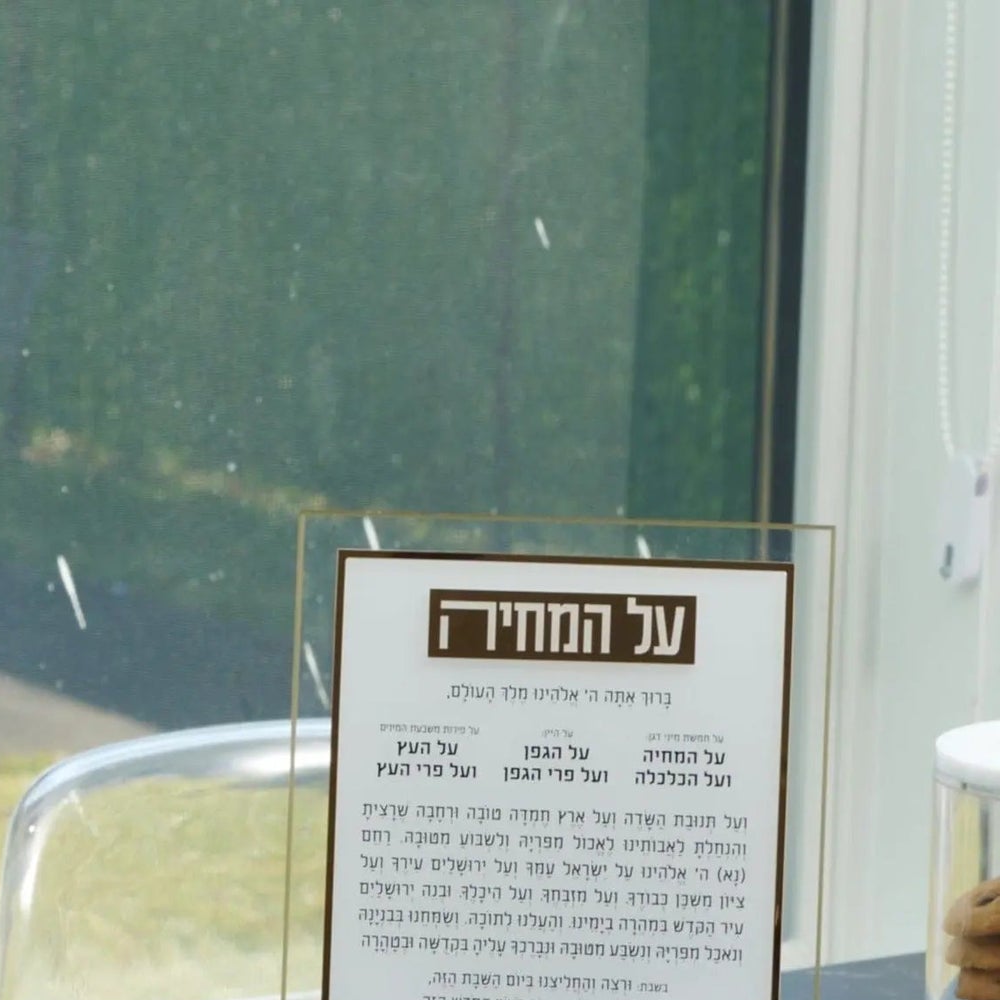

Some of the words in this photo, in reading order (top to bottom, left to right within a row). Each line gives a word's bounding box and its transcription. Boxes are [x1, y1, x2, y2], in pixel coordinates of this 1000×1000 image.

[438, 599, 612, 655] המחיה
[626, 597, 686, 656] על
[396, 740, 430, 756] העץ
[436, 741, 458, 756] על
[523, 745, 562, 760] הגפן
[568, 745, 589, 760] על
[643, 749, 697, 764] המחיה
[703, 750, 725, 765] על
[376, 762, 410, 777] העץ
[416, 763, 443, 777] פרי
[449, 763, 476, 778] ועל
[503, 766, 541, 782] הגפן
[547, 768, 574, 782] פרי
[580, 767, 608, 783] ועל
[635, 769, 698, 786] הכלכלה
[703, 772, 731, 787] ועל
